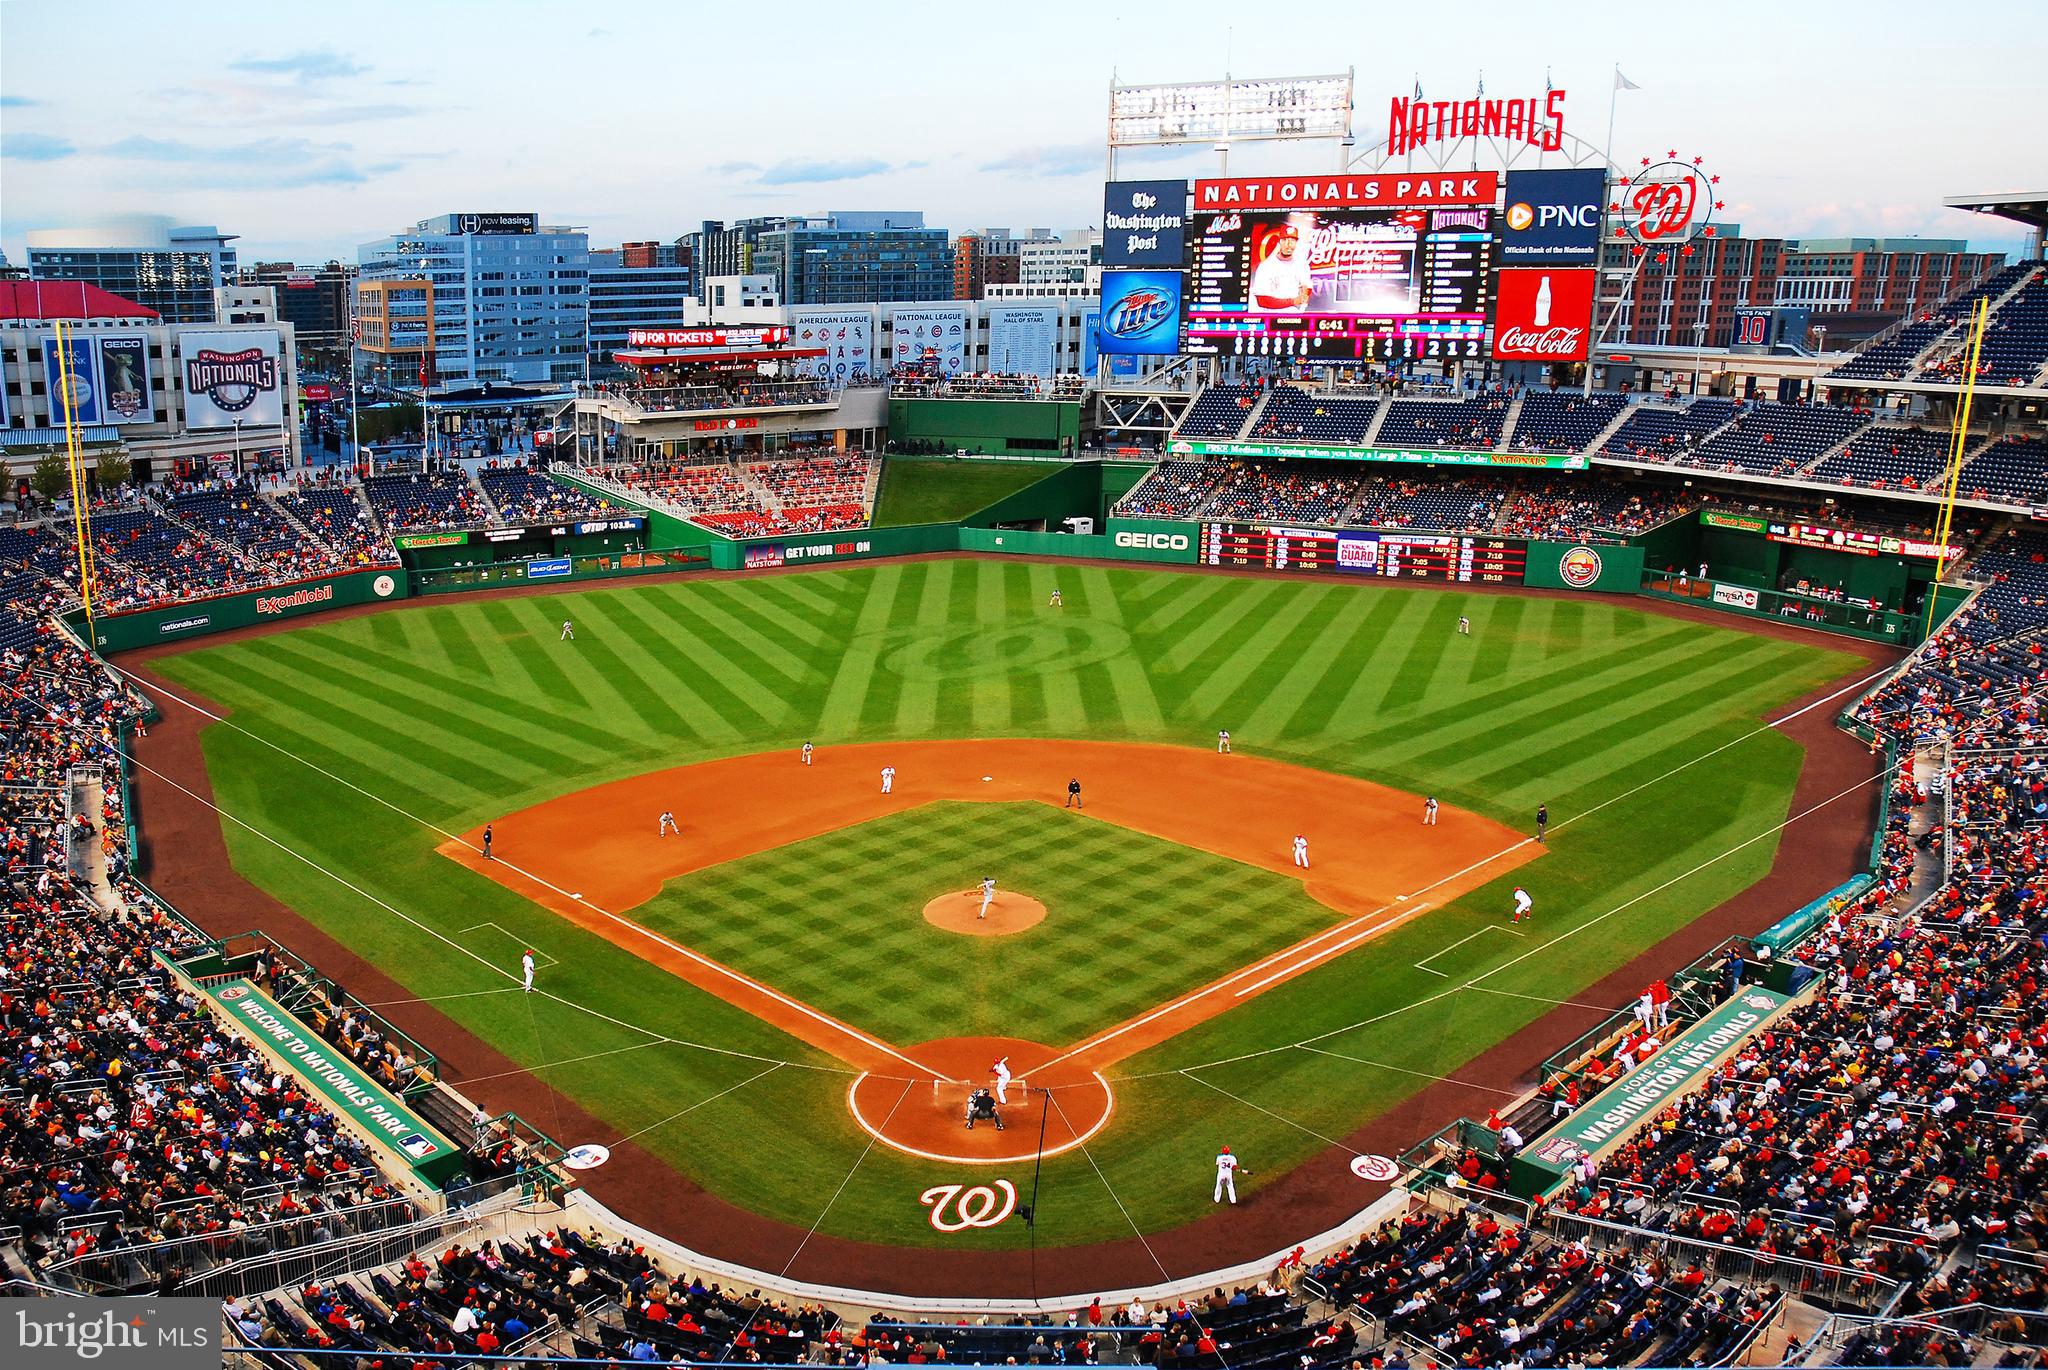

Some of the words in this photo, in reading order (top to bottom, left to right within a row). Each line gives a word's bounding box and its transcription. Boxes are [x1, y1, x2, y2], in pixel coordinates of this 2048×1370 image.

[1388, 90, 1565, 156] NATIONALS
[1205, 181, 1380, 202] NATIONALS
[1396, 179, 1479, 197] PARK
[1132, 192, 1157, 210] The
[482, 217, 498, 225] now
[500, 215, 532, 226] leasing.
[1105, 211, 1182, 232] Washington
[1206, 214, 1242, 234] Mets
[1431, 209, 1488, 230] NATIONALS
[1537, 204, 1598, 227] PNC
[1127, 234, 1157, 254] Post
[1504, 246, 1527, 254] Official
[1124, 293, 1158, 309] Miller
[1114, 300, 1169, 335] Lite
[1319, 320, 1344, 330] 6:41
[647, 332, 665, 342] FOR
[667, 331, 713, 343] TICKETS
[1738, 316, 1765, 344] 10
[104, 340, 141, 349] GEICO
[1428, 341, 1440, 356] 2
[1447, 341, 1458, 356] 1
[1498, 326, 1584, 353] Coca-Cola
[201, 351, 260, 362] WASHINGTON
[1466, 341, 1478, 357] 2
[190, 360, 273, 389] NATIONALS
[694, 420, 718, 431] RED
[1205, 444, 1228, 453] FREE
[1231, 445, 1263, 455] Medium
[1266, 446, 1306, 457] 1-Topping
[1307, 448, 1330, 457] when
[1332, 449, 1346, 458] you
[1348, 448, 1364, 459] buy
[1373, 452, 1397, 461] Large
[1432, 453, 1460, 462] Promo
[1463, 453, 1488, 463] Code:
[1490, 454, 1548, 465] NATIONALS
[1115, 531, 1189, 550] GEICO
[1801, 540, 1824, 548] NATIONALS
[786, 547, 805, 559] GET
[806, 544, 833, 557] YOUR
[835, 543, 855, 554] RED
[856, 541, 870, 552] ON
[1341, 550, 1374, 562] GUARD
[1487, 552, 1503, 560] 7:10
[530, 564, 547, 573] BUD
[547, 563, 569, 573] LIGHT
[747, 559, 782, 568] NATSTOWN
[1299, 561, 1318, 569] 10:05
[1412, 558, 1428, 566] 7:05
[257, 585, 332, 615] ExxonMobil
[161, 616, 208, 631] nationals.com
[237, 998, 296, 1041] WELCOME
[285, 1037, 309, 1054] TO
[298, 1050, 374, 1108] NATIONALS
[364, 1100, 411, 1136] PARK
[1620, 1067, 1657, 1094] HOME
[1654, 1056, 1673, 1069] OF
[1669, 1039, 1696, 1057] THE
[1577, 1065, 1690, 1143] WASHINGTON
[1677, 1010, 1759, 1068] NATIONALS
[918, 1178, 1018, 1233] W
